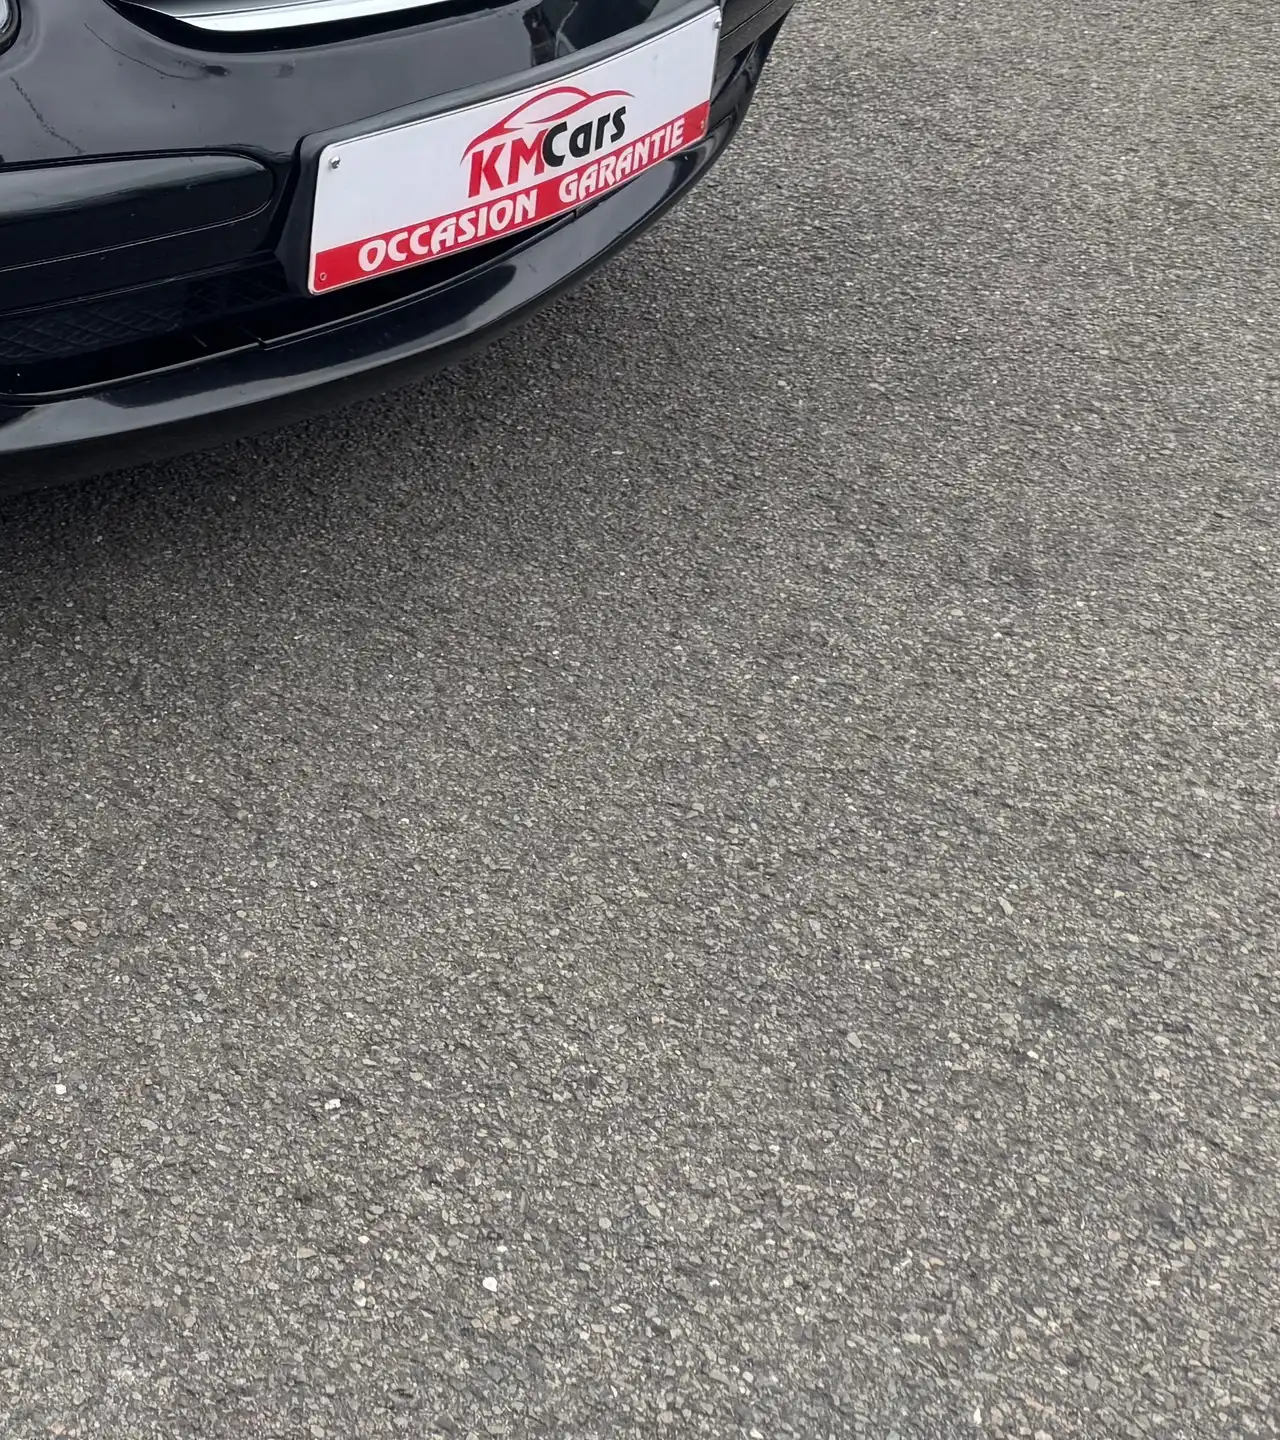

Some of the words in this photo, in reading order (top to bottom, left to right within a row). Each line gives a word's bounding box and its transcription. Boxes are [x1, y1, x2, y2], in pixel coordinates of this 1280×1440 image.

[357, 189, 539, 274] OCCASION
[558, 117, 684, 205] GARANTIE
[467, 105, 627, 199] KMCars
